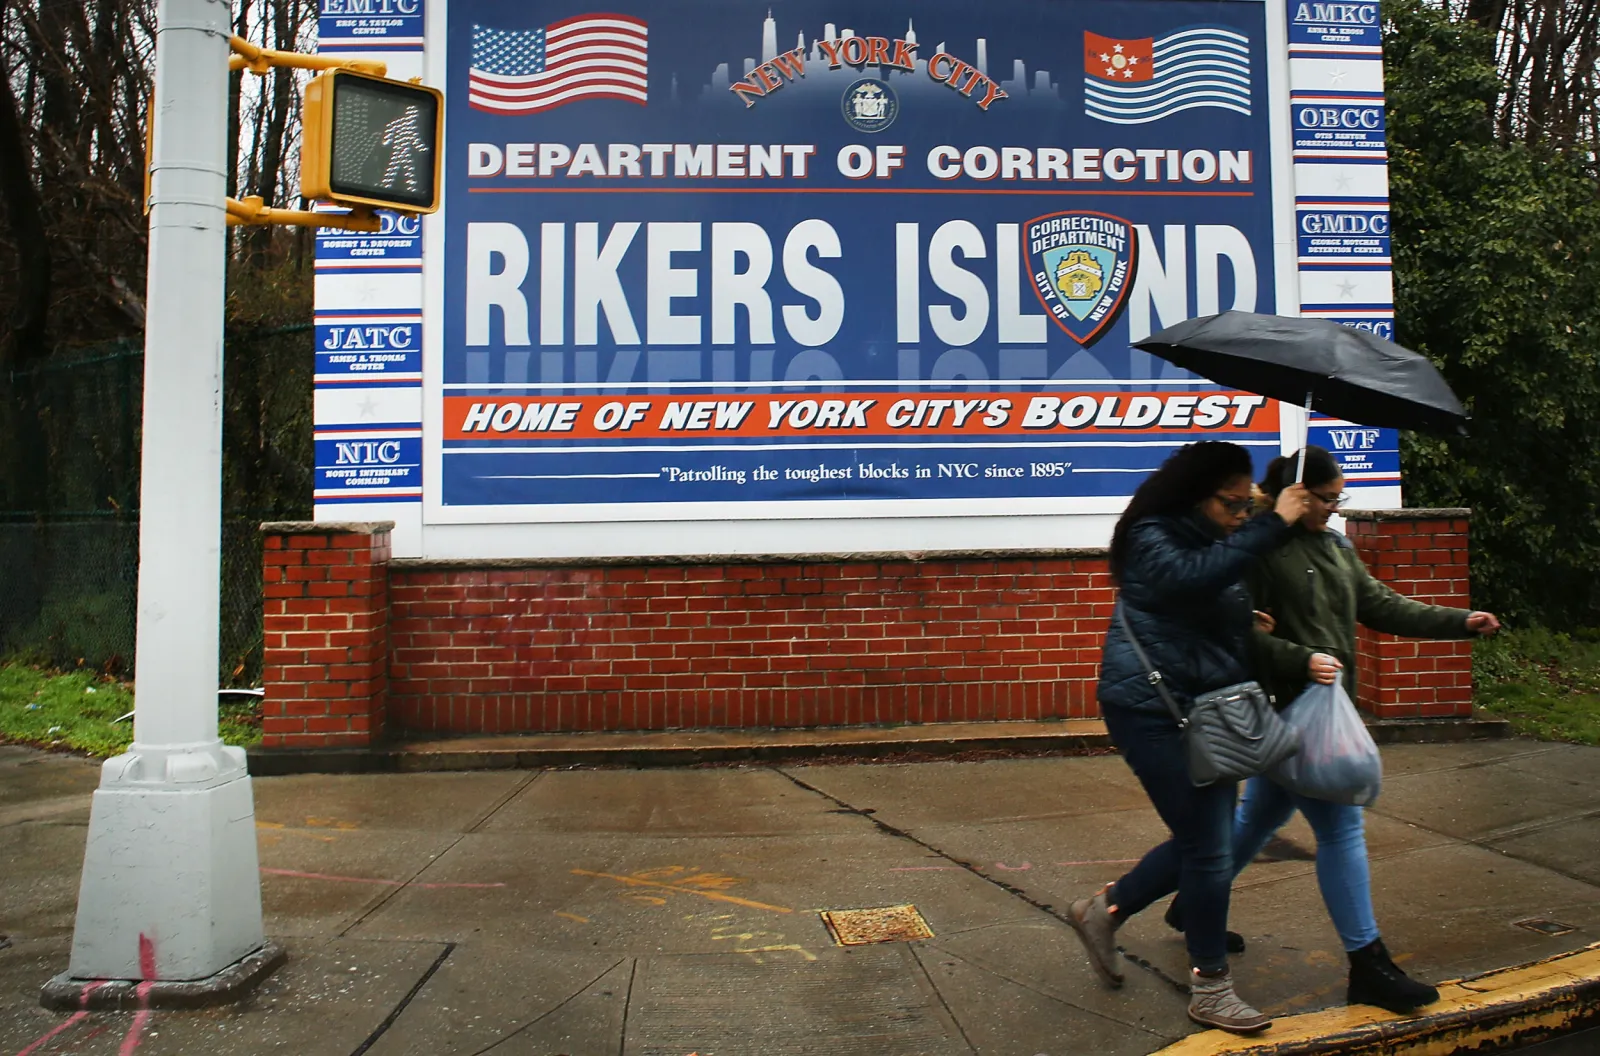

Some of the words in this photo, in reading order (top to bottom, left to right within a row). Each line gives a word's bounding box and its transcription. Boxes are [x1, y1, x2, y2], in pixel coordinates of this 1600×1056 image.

[321, 0, 419, 14] EMTC
[1294, 2, 1376, 24] AMKC
[352, 27, 387, 35] CENTER
[369, 19, 404, 27] TAYLOR
[728, 46, 806, 109] NEW
[817, 36, 920, 70] YORK
[927, 50, 1010, 112] CITY
[1299, 107, 1380, 128] OBCC
[467, 143, 816, 179] DEPARTMENT
[837, 145, 906, 179] OF
[927, 145, 1254, 184] CORRECTION
[1030, 217, 1126, 239] CORRECTION
[1301, 213, 1388, 234] GMDC
[323, 240, 358, 248] ROBERT
[350, 248, 385, 256] CENTER
[1032, 231, 1126, 254] DEPARTMENT
[465, 218, 845, 347] RIKERS
[1089, 295, 1114, 322] NEW
[1108, 260, 1128, 293] YORK
[1035, 271, 1057, 301] CITY
[1052, 303, 1070, 320] OF
[324, 326, 412, 349] JATC
[329, 355, 357, 363] JAMES
[369, 354, 406, 362] THOMAS
[461, 401, 583, 433] HOME
[592, 401, 657, 432] OF
[659, 400, 757, 431] NEW
[766, 399, 881, 429] YORK
[885, 398, 1014, 429] CITY'S
[1021, 395, 1266, 430] BOLDEST
[1328, 428, 1379, 450] WF
[335, 440, 401, 464] NIC
[325, 469, 357, 478] NORTH
[359, 468, 410, 477] INFIRMARY
[345, 477, 390, 486] COMMAND
[752, 465, 779, 481] the
[785, 464, 853, 482] toughest
[859, 463, 909, 479] blocks
[915, 464, 932, 479] in
[937, 463, 979, 478] NYC
[984, 463, 1025, 478] since
